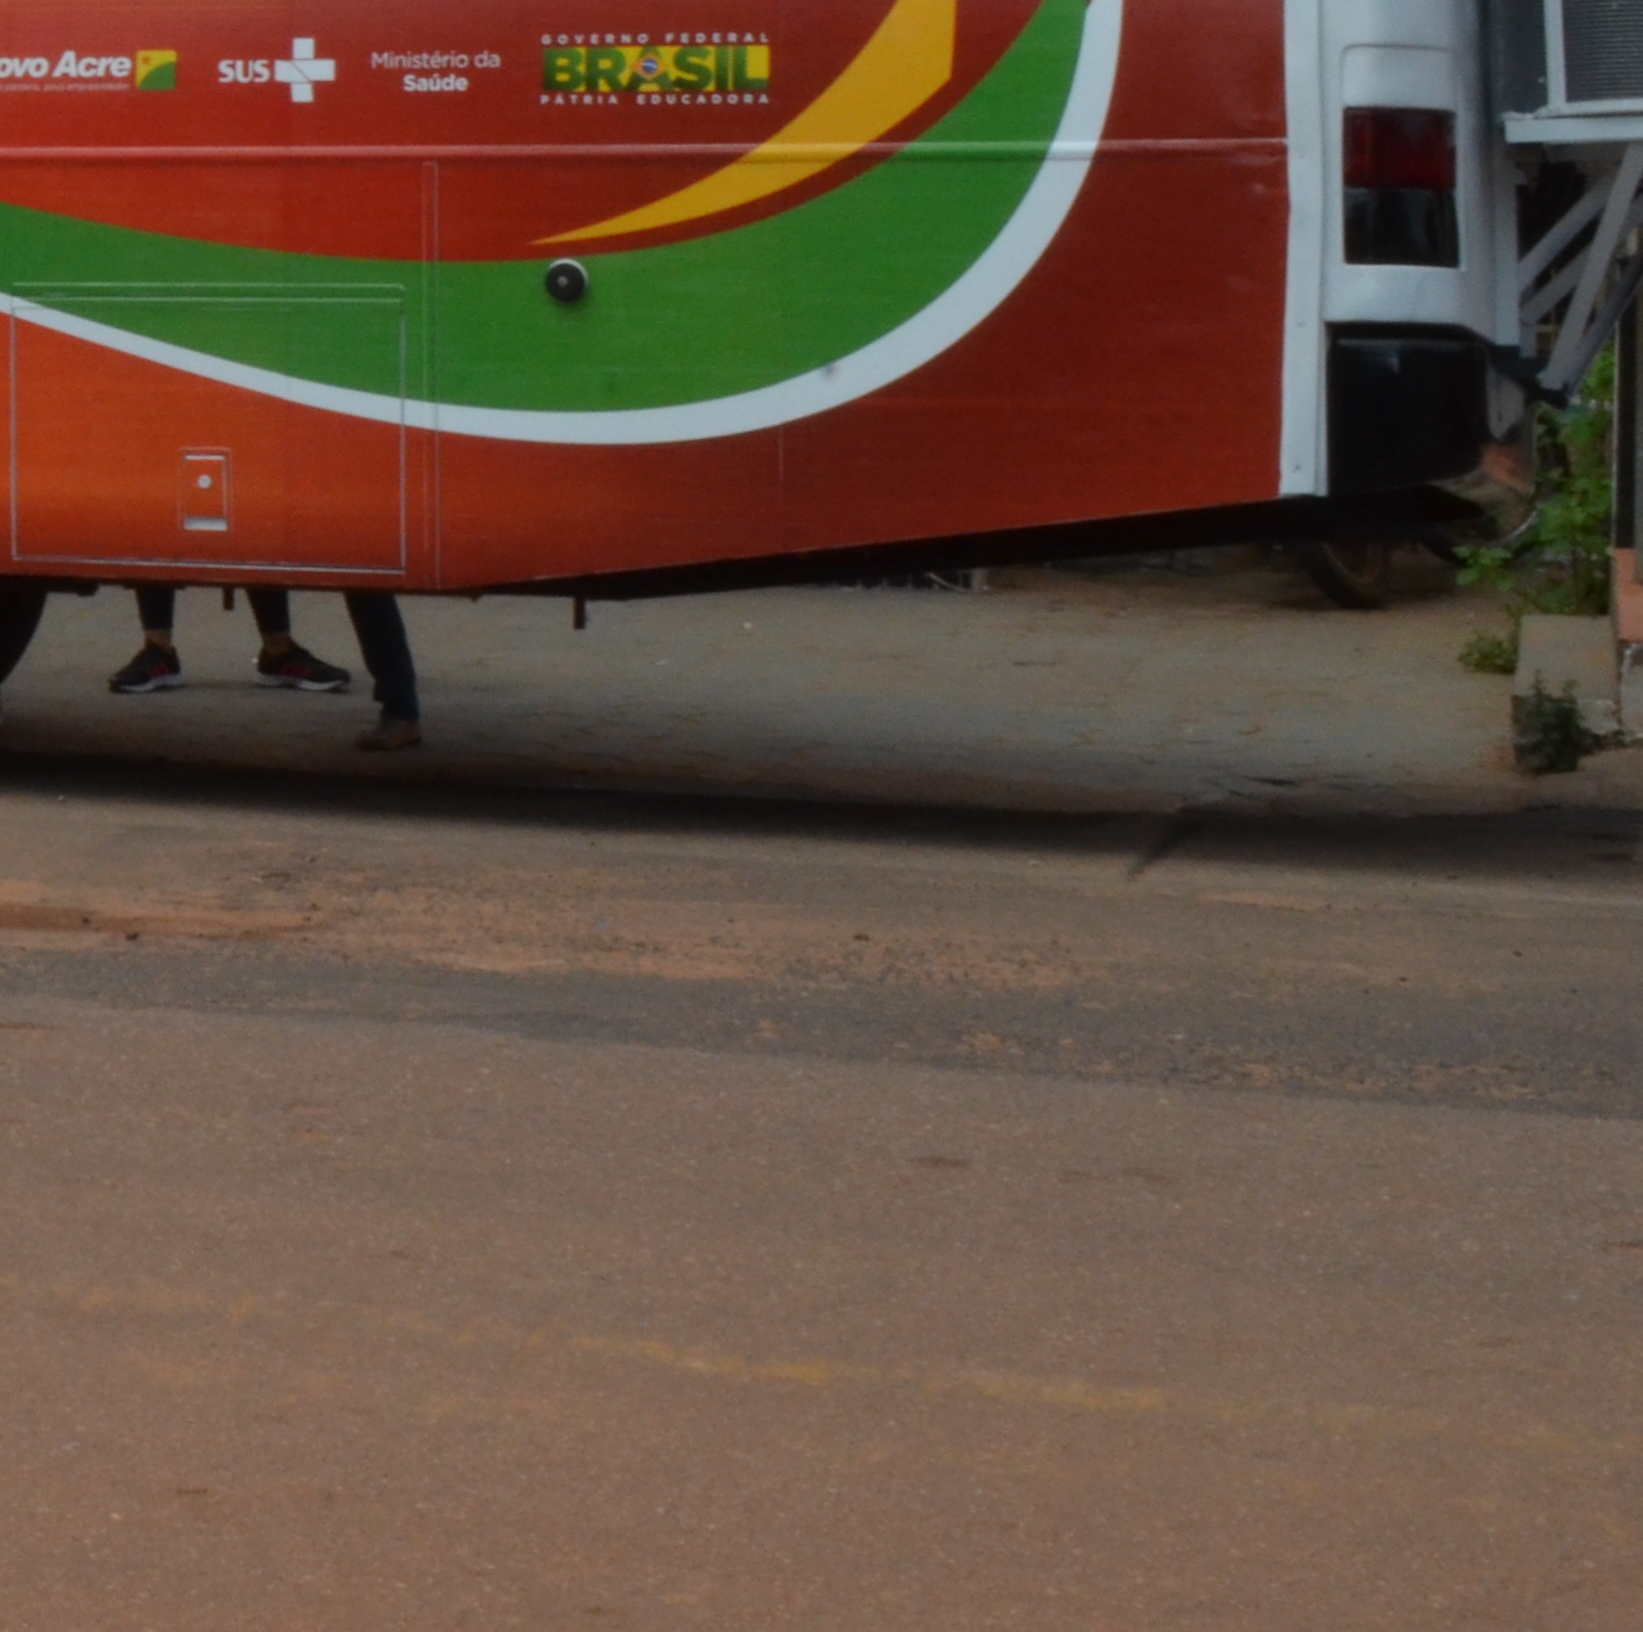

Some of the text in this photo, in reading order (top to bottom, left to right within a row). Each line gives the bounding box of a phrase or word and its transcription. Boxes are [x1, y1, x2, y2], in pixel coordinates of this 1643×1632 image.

[540, 32, 770, 45] GOVERNO FEDERAL
[53, 49, 133, 78] Acre
[370, 49, 501, 69] Ministério da
[543, 46, 770, 91] BRASIL
[218, 60, 270, 84] SUS
[402, 73, 469, 92] Saúde
[540, 92, 770, 105] PÁTRIA EDUCADORA
